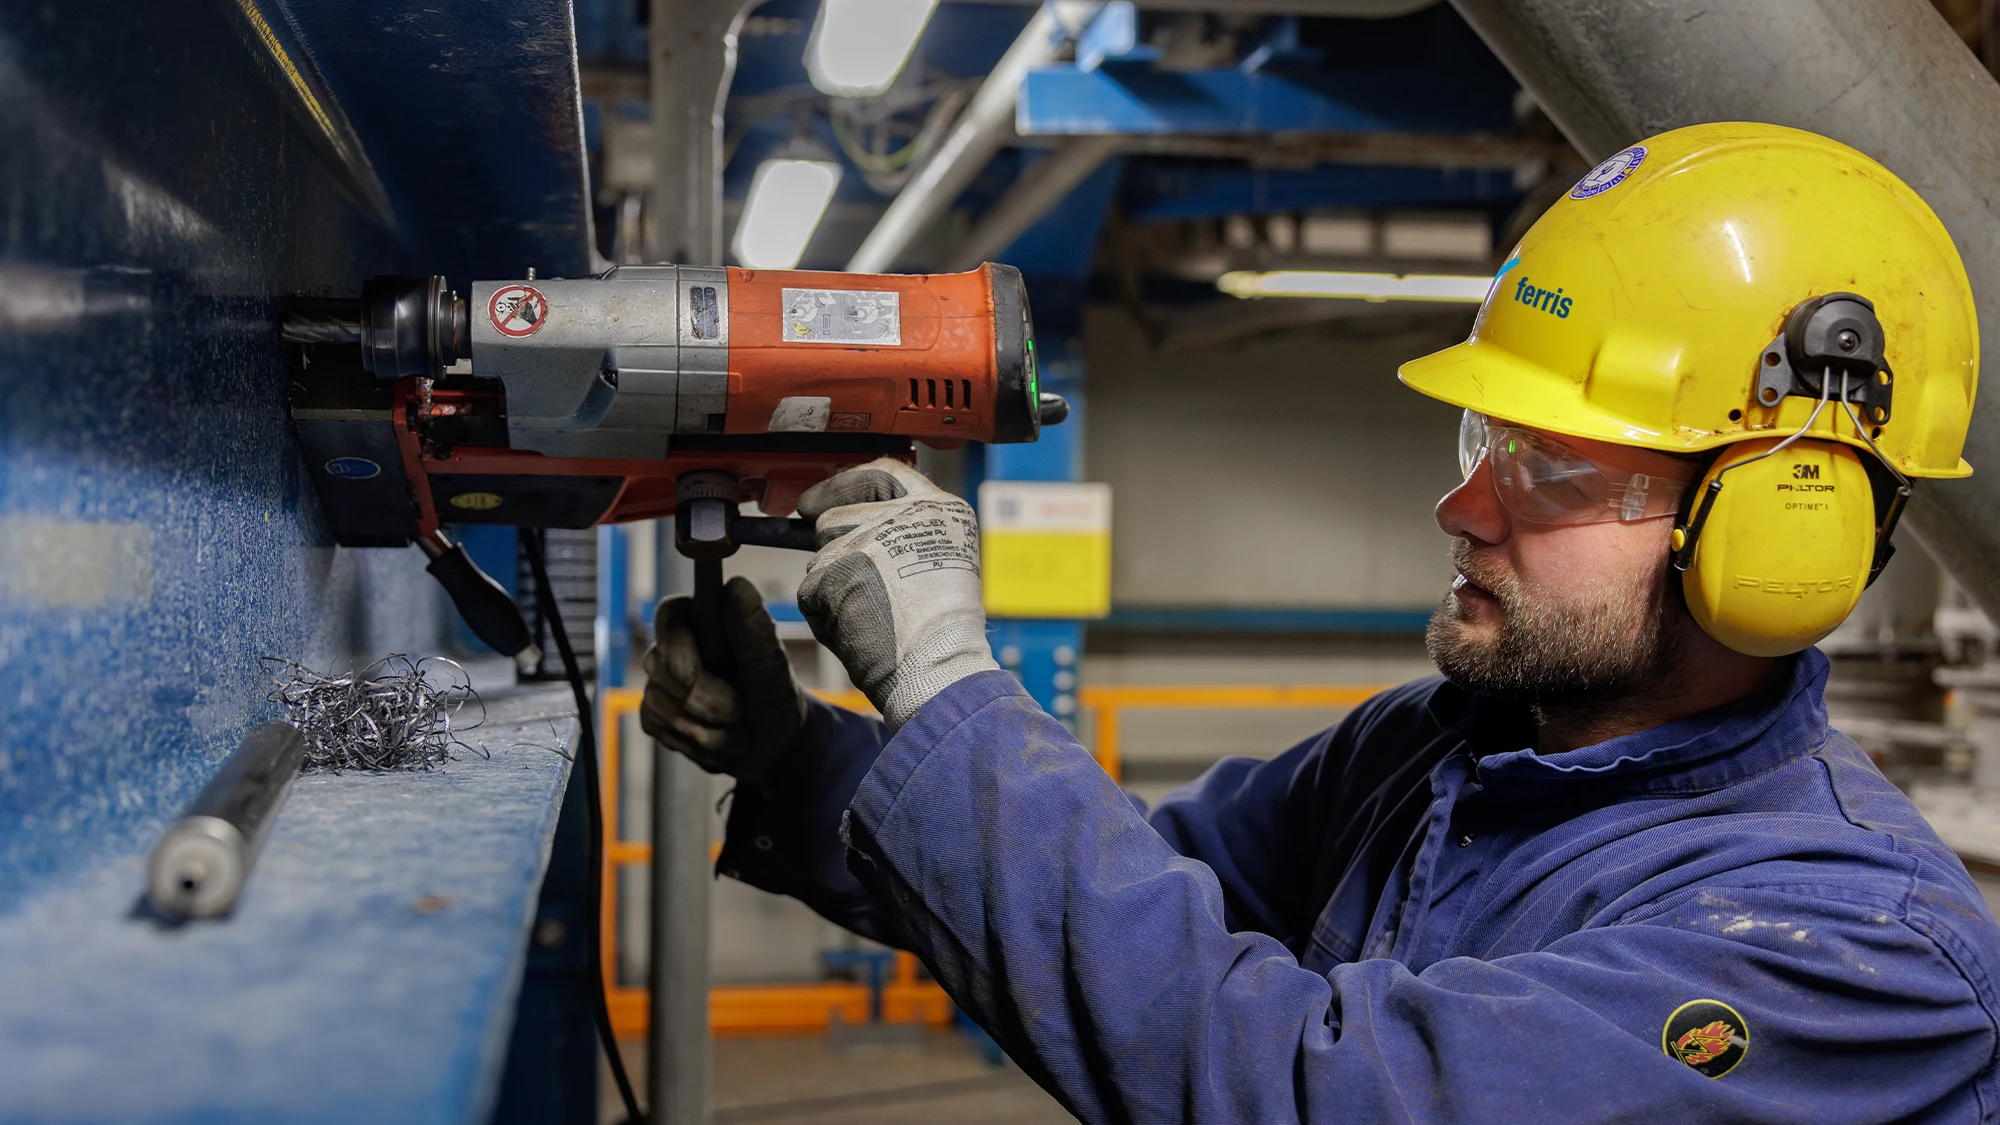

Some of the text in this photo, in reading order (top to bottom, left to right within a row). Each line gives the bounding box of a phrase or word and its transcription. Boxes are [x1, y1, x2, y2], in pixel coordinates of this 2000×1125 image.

[1514, 276, 1573, 319] ferris
[1792, 464, 1820, 480] 3M
[1733, 574, 1854, 595] PELTOR
